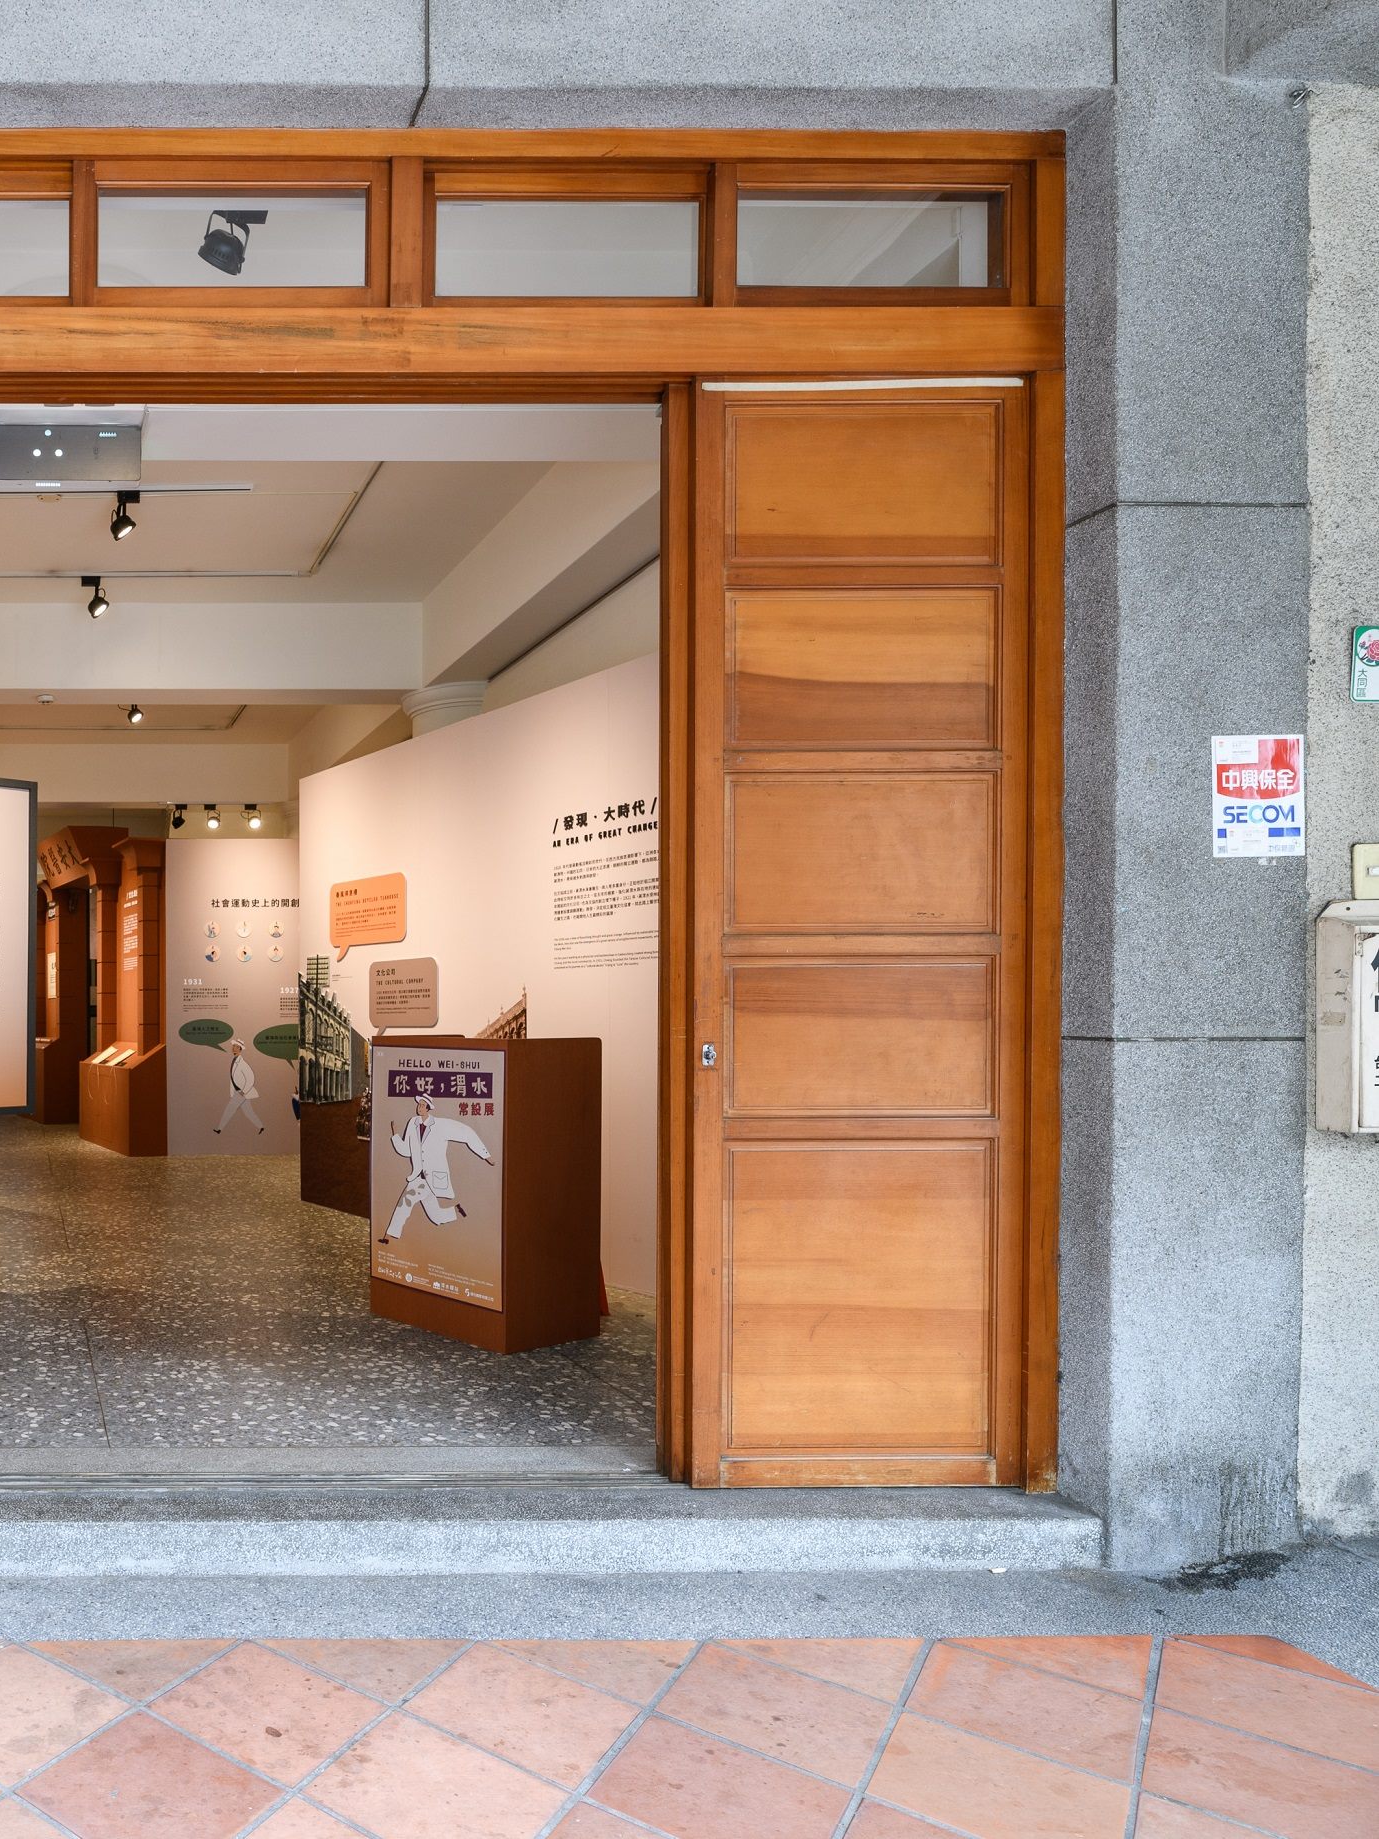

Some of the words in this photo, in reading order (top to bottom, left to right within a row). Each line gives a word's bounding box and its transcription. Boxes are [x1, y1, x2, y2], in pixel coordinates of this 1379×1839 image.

[1222, 769, 1294, 790] 中興保全
[1223, 805, 1294, 823] SECOM
[566, 836, 579, 846] ERA
[584, 833, 593, 842] OF
[598, 828, 622, 840] GREAT
[399, 1059, 431, 1068] HELLO
[438, 1060, 480, 1069] WEI-SHUI
[459, 1102, 494, 1116] 常設展
